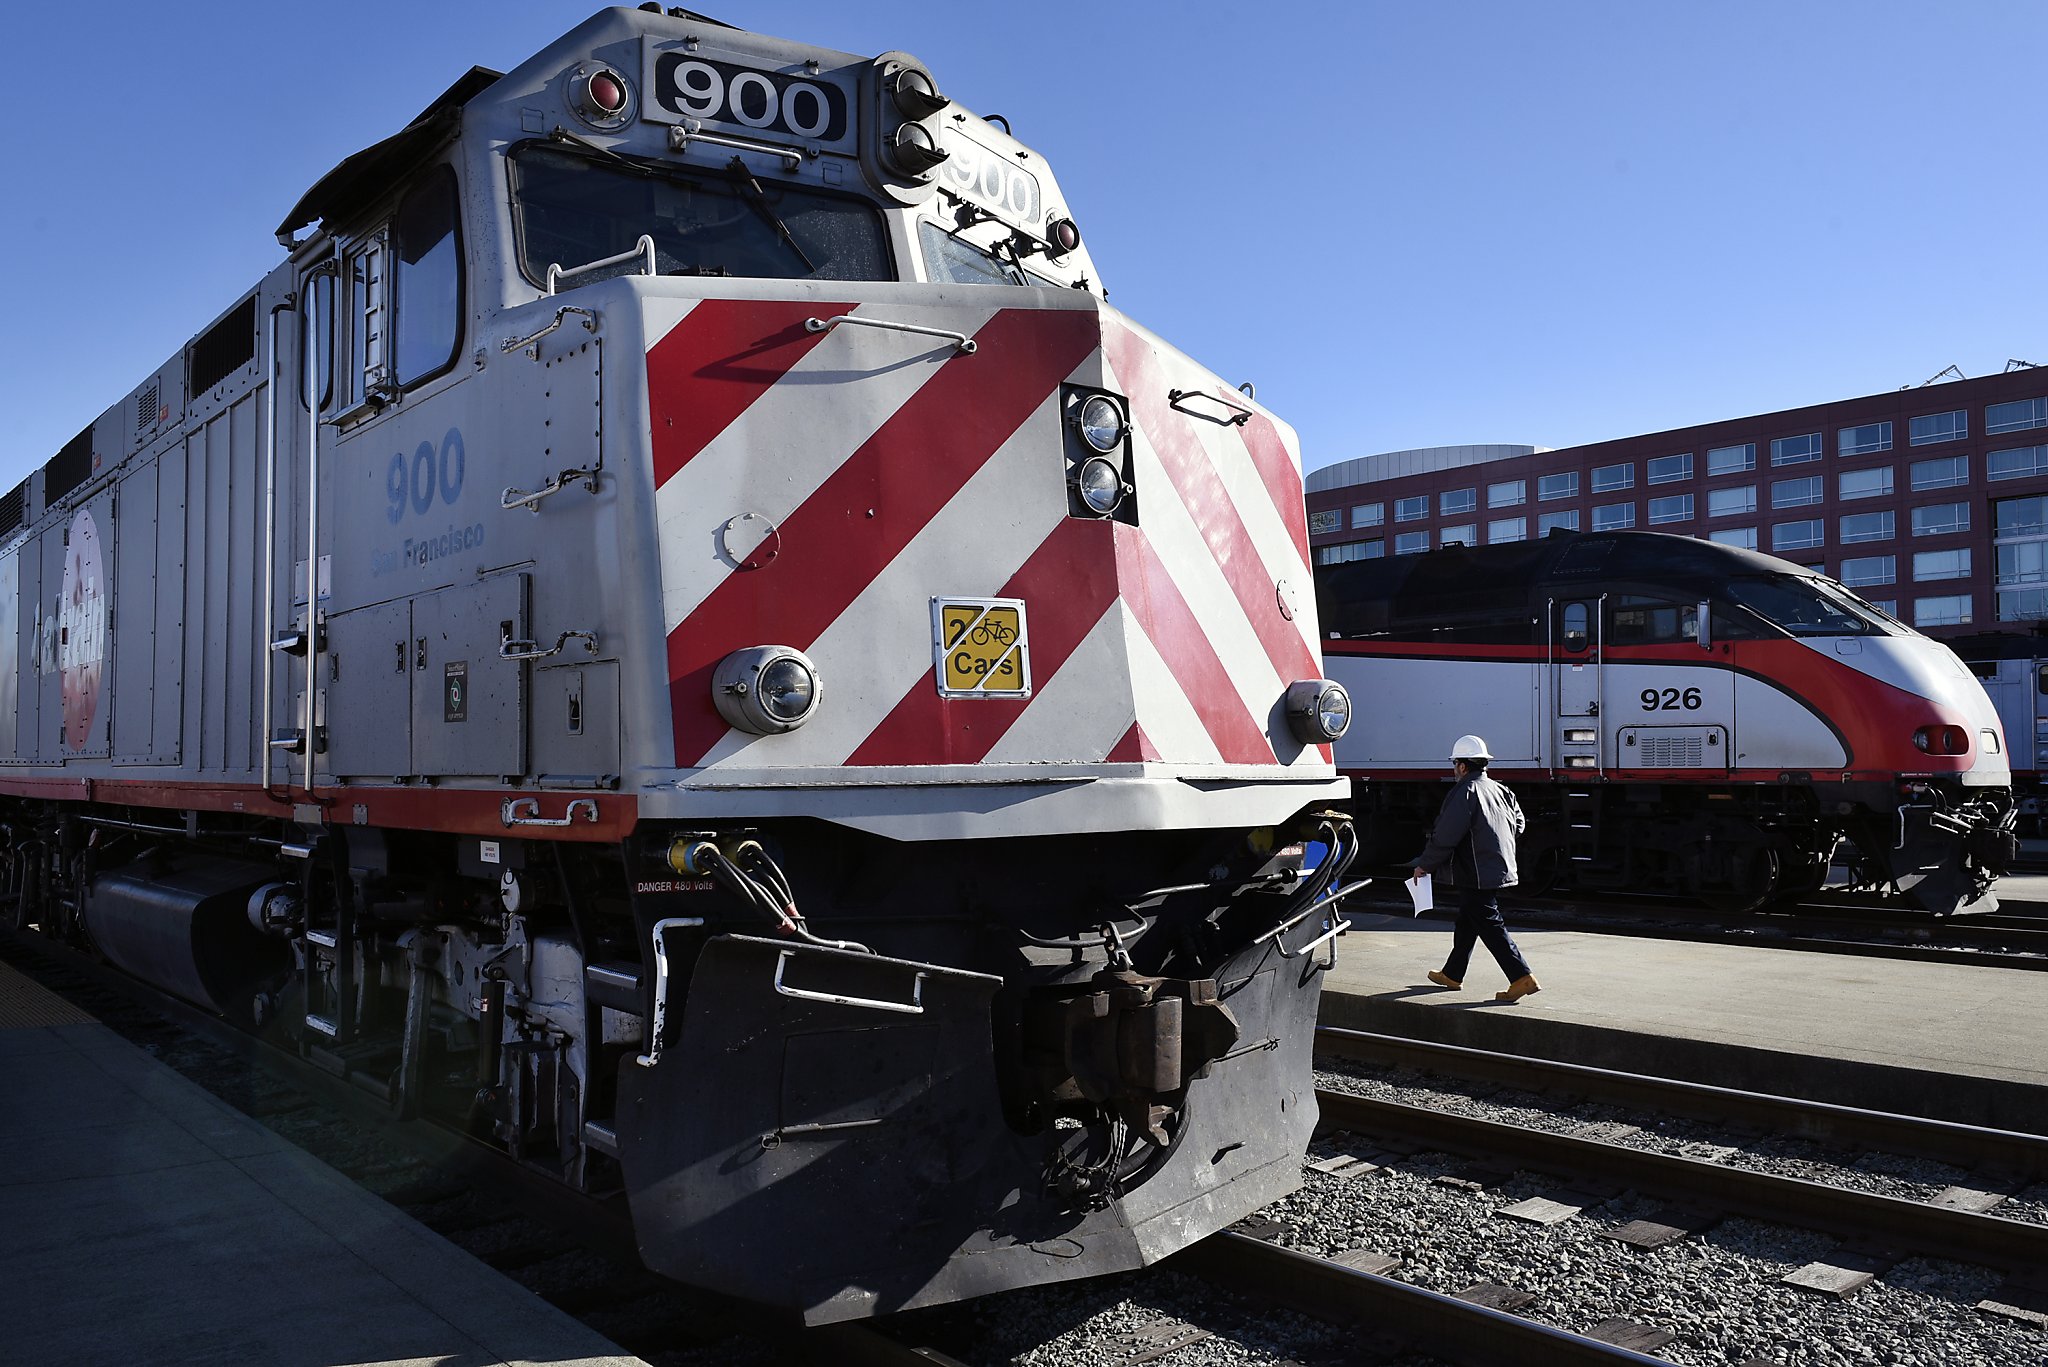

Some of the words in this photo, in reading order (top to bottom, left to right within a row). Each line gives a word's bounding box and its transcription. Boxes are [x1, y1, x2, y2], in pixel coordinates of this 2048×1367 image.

[673, 61, 831, 138] 900
[949, 140, 1033, 220] 900
[387, 426, 466, 526] 900
[403, 523, 485, 569] Francisco
[31, 576, 105, 677] atrain
[949, 618, 967, 646] 2
[954, 651, 1014, 676] Cars
[1640, 687, 1703, 712] 926
[637, 881, 672, 893] DANGER
[674, 881, 691, 891] 480
[694, 880, 713, 890] Volts
